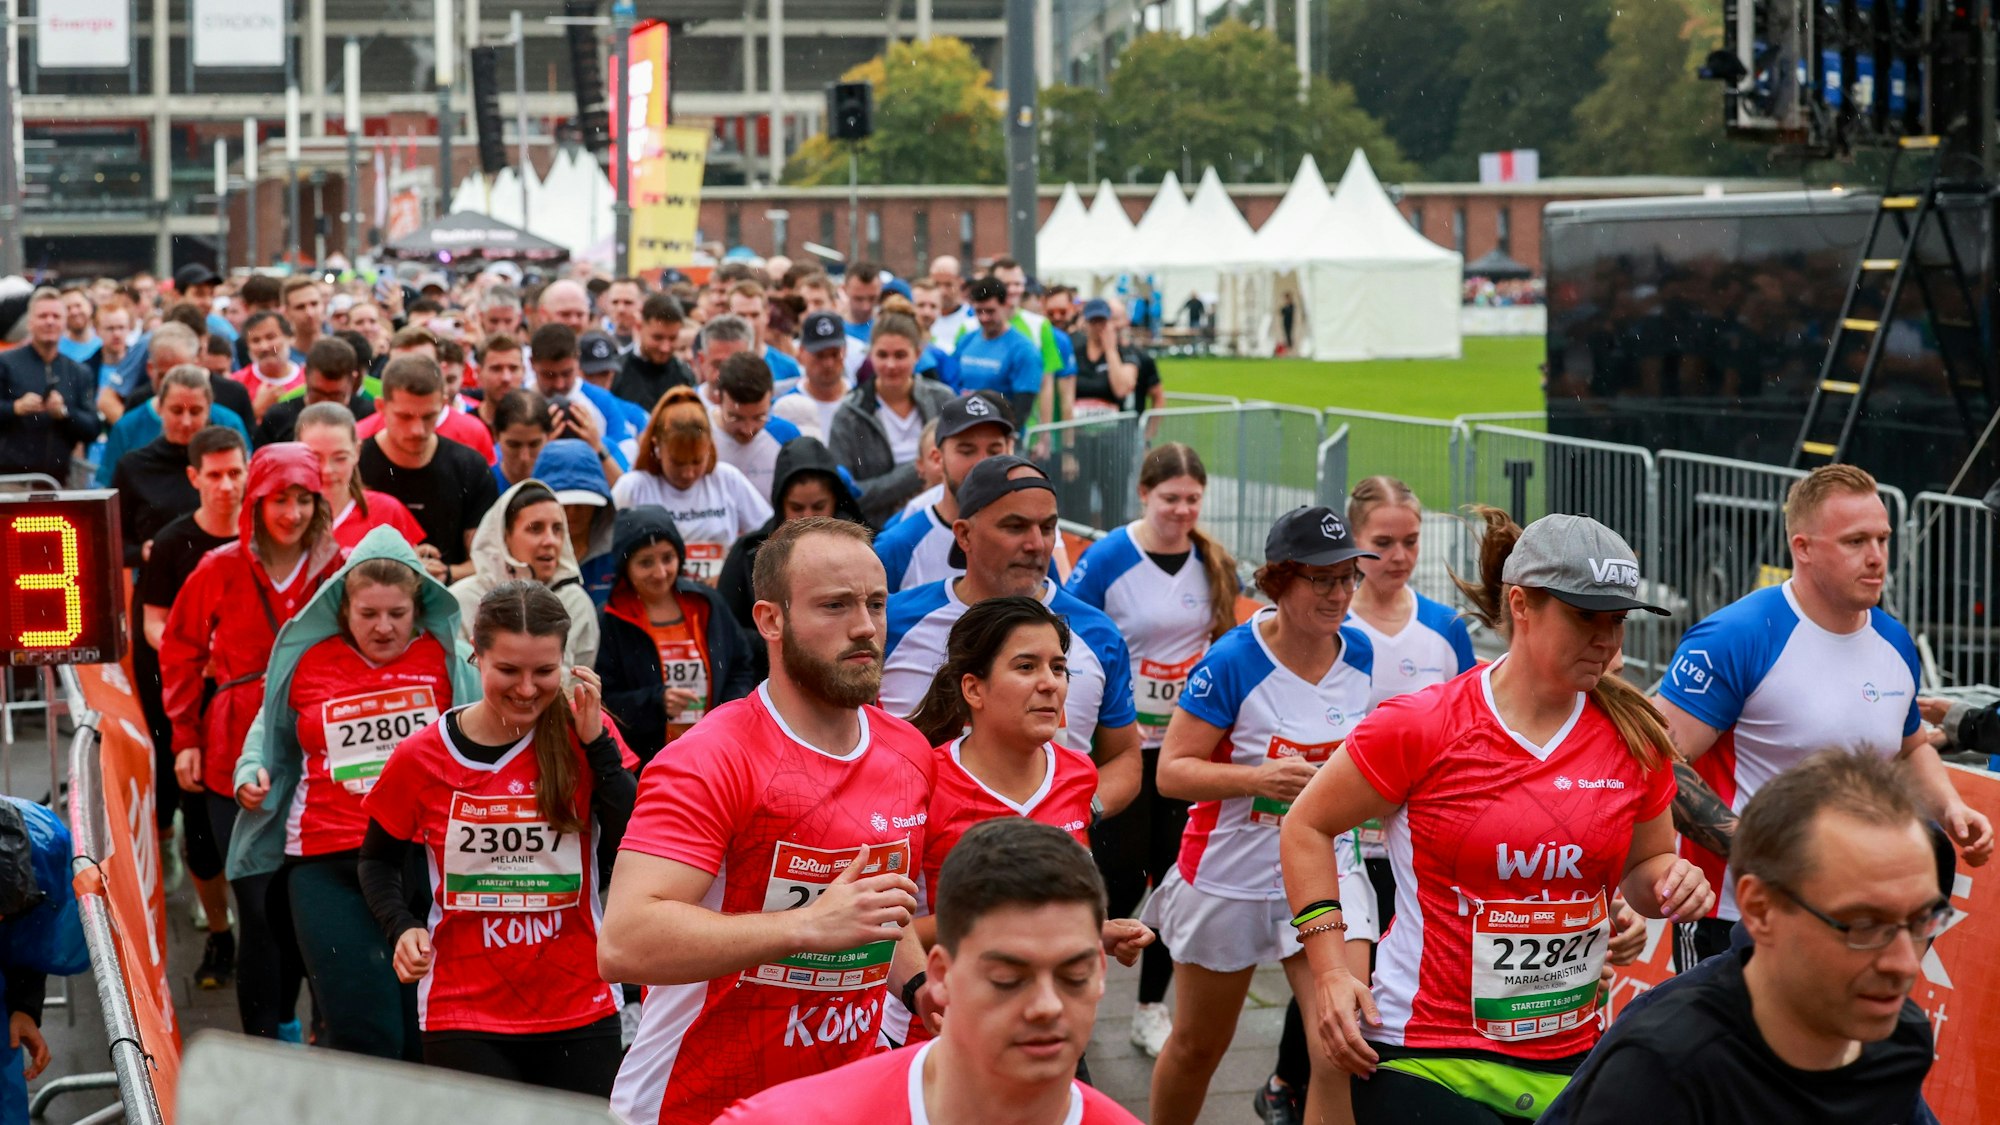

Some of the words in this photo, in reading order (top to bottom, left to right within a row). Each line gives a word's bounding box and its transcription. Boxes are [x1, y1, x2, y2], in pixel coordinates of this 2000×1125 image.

[11, 515, 82, 647] 3
[1588, 558, 1639, 588] VANS
[1679, 658, 1707, 684] LYB
[339, 712, 428, 748] 22805
[1578, 778, 1606, 789] Stadt
[1606, 778, 1625, 789] Köln
[892, 814, 917, 828] Stadt
[459, 826, 563, 853] 23057
[491, 855, 534, 863] MELANIE
[789, 855, 831, 873] B2Run
[477, 879, 513, 887] STARTZEIT
[516, 879, 535, 887] 16:30
[537, 879, 550, 887] Uhr
[1489, 910, 1530, 924] B2Run
[838, 953, 856, 963] 16:30
[856, 952, 869, 960] Uhr
[1493, 928, 1601, 970] 22827
[1504, 963, 1588, 985] MARIA-CHRISTINA
[1511, 999, 1552, 1011] STARTZEIT
[1553, 996, 1572, 1006] 16:30
[1572, 994, 1582, 1002] Uhr
